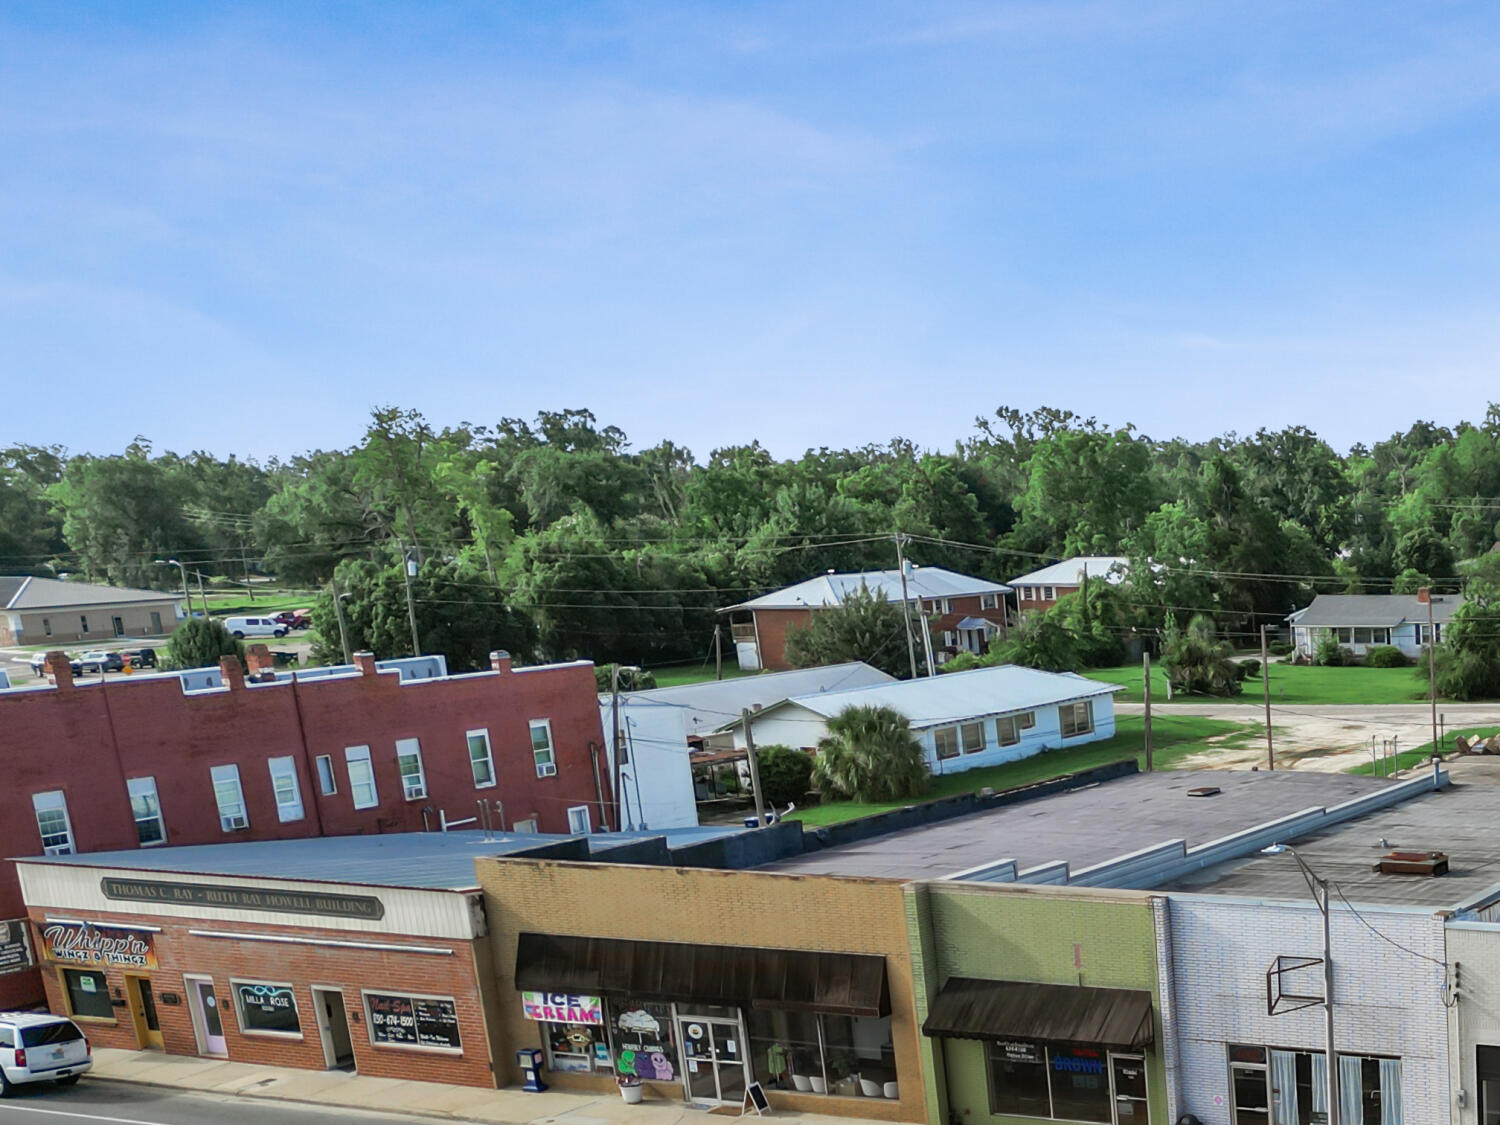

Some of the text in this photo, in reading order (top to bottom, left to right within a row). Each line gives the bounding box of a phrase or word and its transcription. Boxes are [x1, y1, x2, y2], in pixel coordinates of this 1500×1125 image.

[111, 883, 157, 898] THOMAS
[173, 888, 194, 900] RAY
[205, 890, 238, 904] RUTH
[242, 892, 262, 906] RAY
[265, 894, 313, 909] HOWELL
[314, 898, 373, 914] BUILDING
[44, 925, 149, 955] Whipp'n
[54, 949, 90, 960] WINGZ
[105, 953, 147, 966] THINGZ
[269, 996, 290, 1008] ROSE
[542, 991, 581, 1008] ICE
[533, 1005, 597, 1023] CREAM
[1053, 1055, 1105, 1075] BROWN
